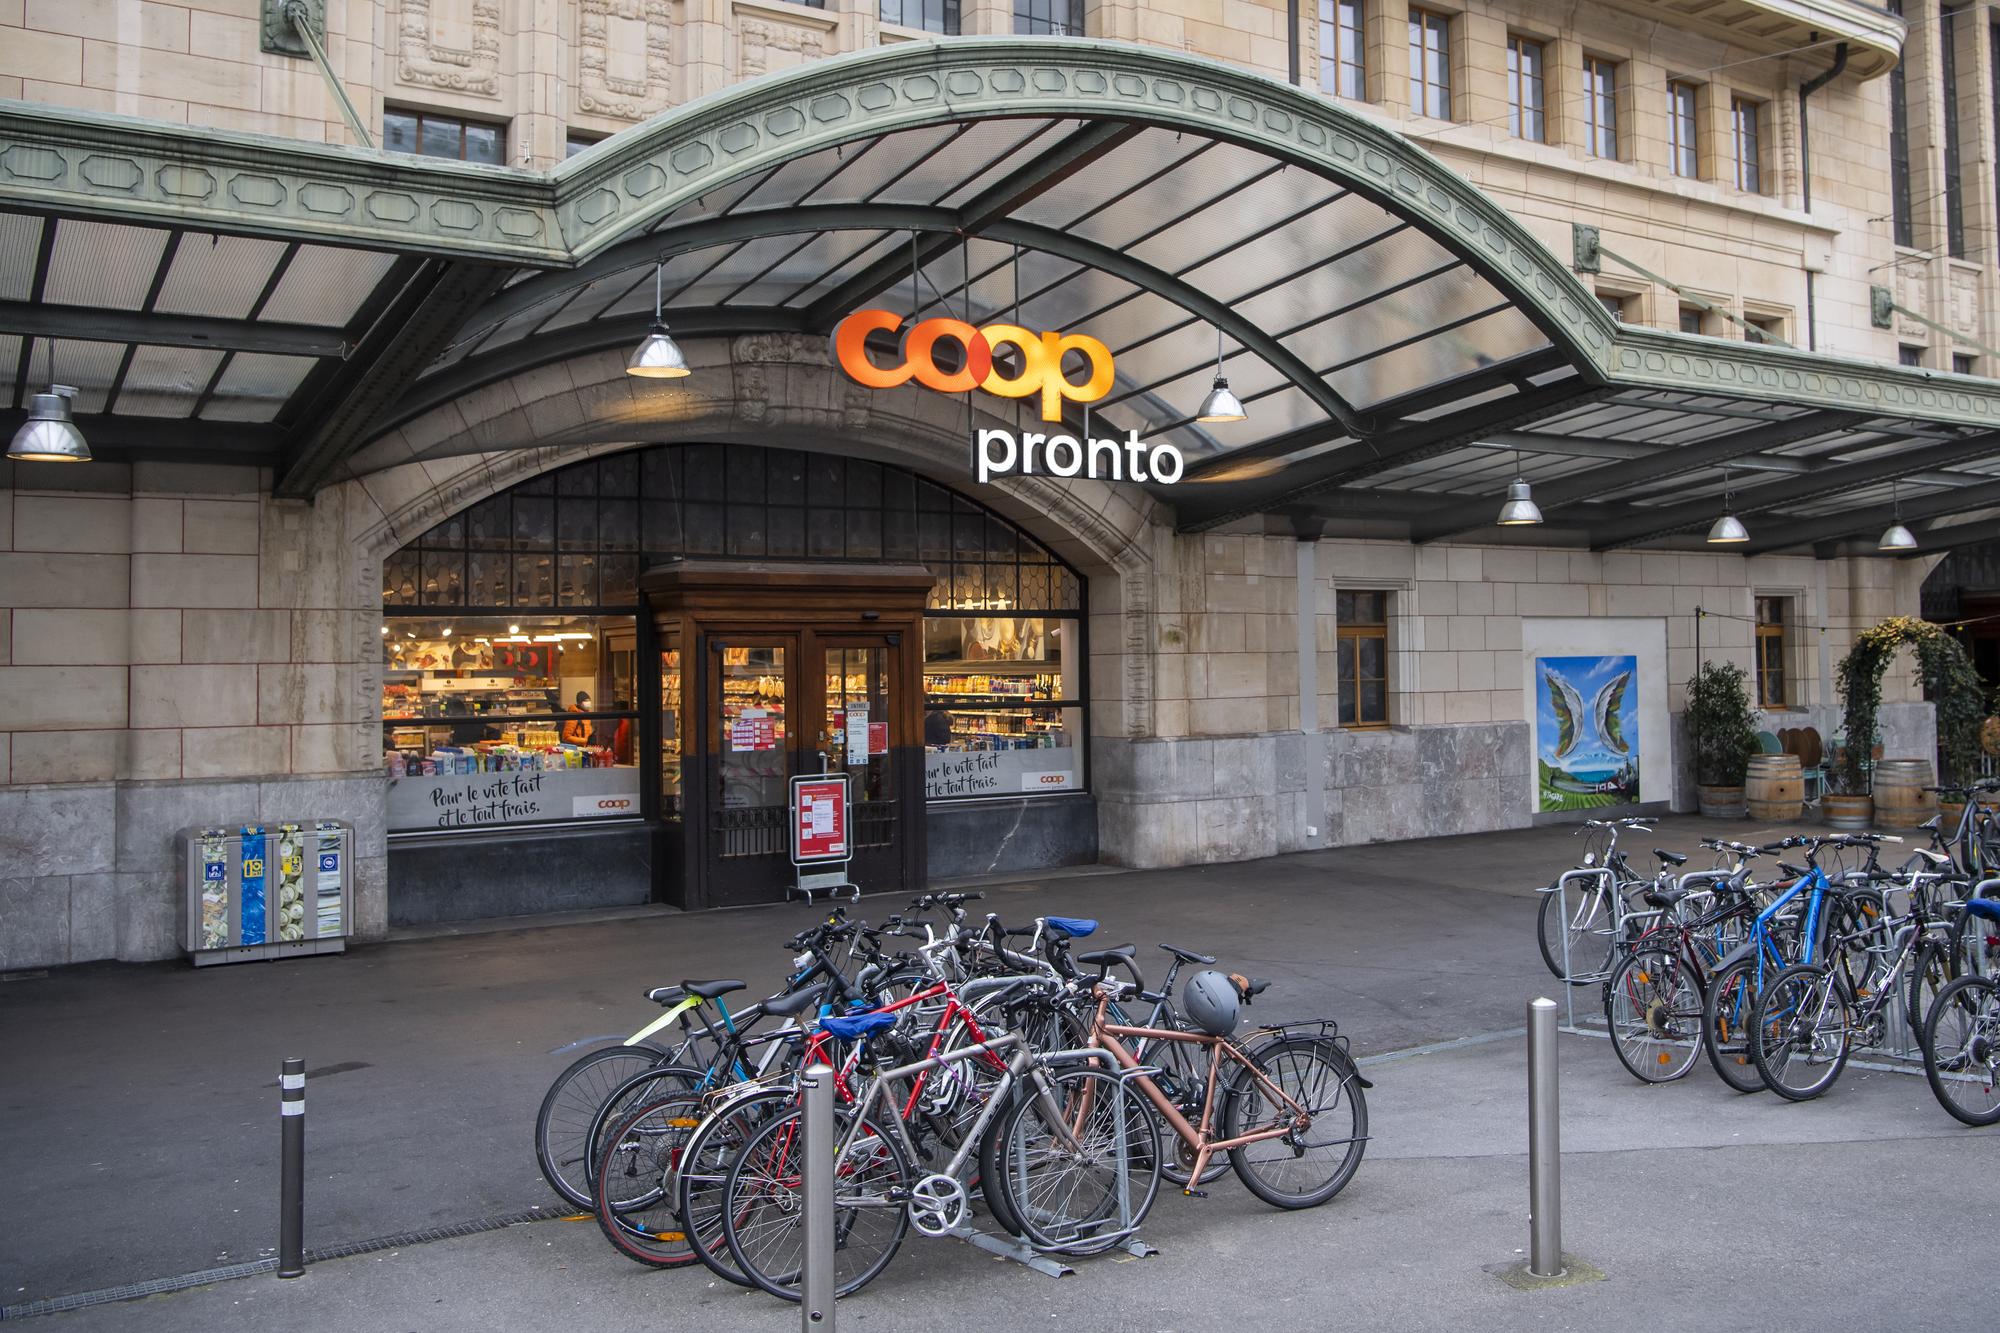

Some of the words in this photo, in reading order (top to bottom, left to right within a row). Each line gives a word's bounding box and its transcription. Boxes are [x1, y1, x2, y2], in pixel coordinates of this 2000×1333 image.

[834, 309, 1115, 422] coop
[977, 429, 1184, 484] pronto
[925, 767, 939, 779] ur
[942, 762, 951, 777] le
[954, 757, 974, 774] vite
[976, 752, 1002, 772] fait
[429, 787, 462, 807] Pour
[467, 785, 478, 802] le
[483, 779, 509, 798] vite
[512, 773, 546, 796] fait
[934, 782, 943, 797] le
[943, 776, 967, 795] tout
[966, 774, 998, 793] frais.
[1040, 775, 1065, 784] coop
[438, 809, 456, 827] et
[455, 808, 468, 825] le
[467, 801, 499, 823] tout
[498, 799, 540, 821] frais.
[598, 800, 630, 809] coop
